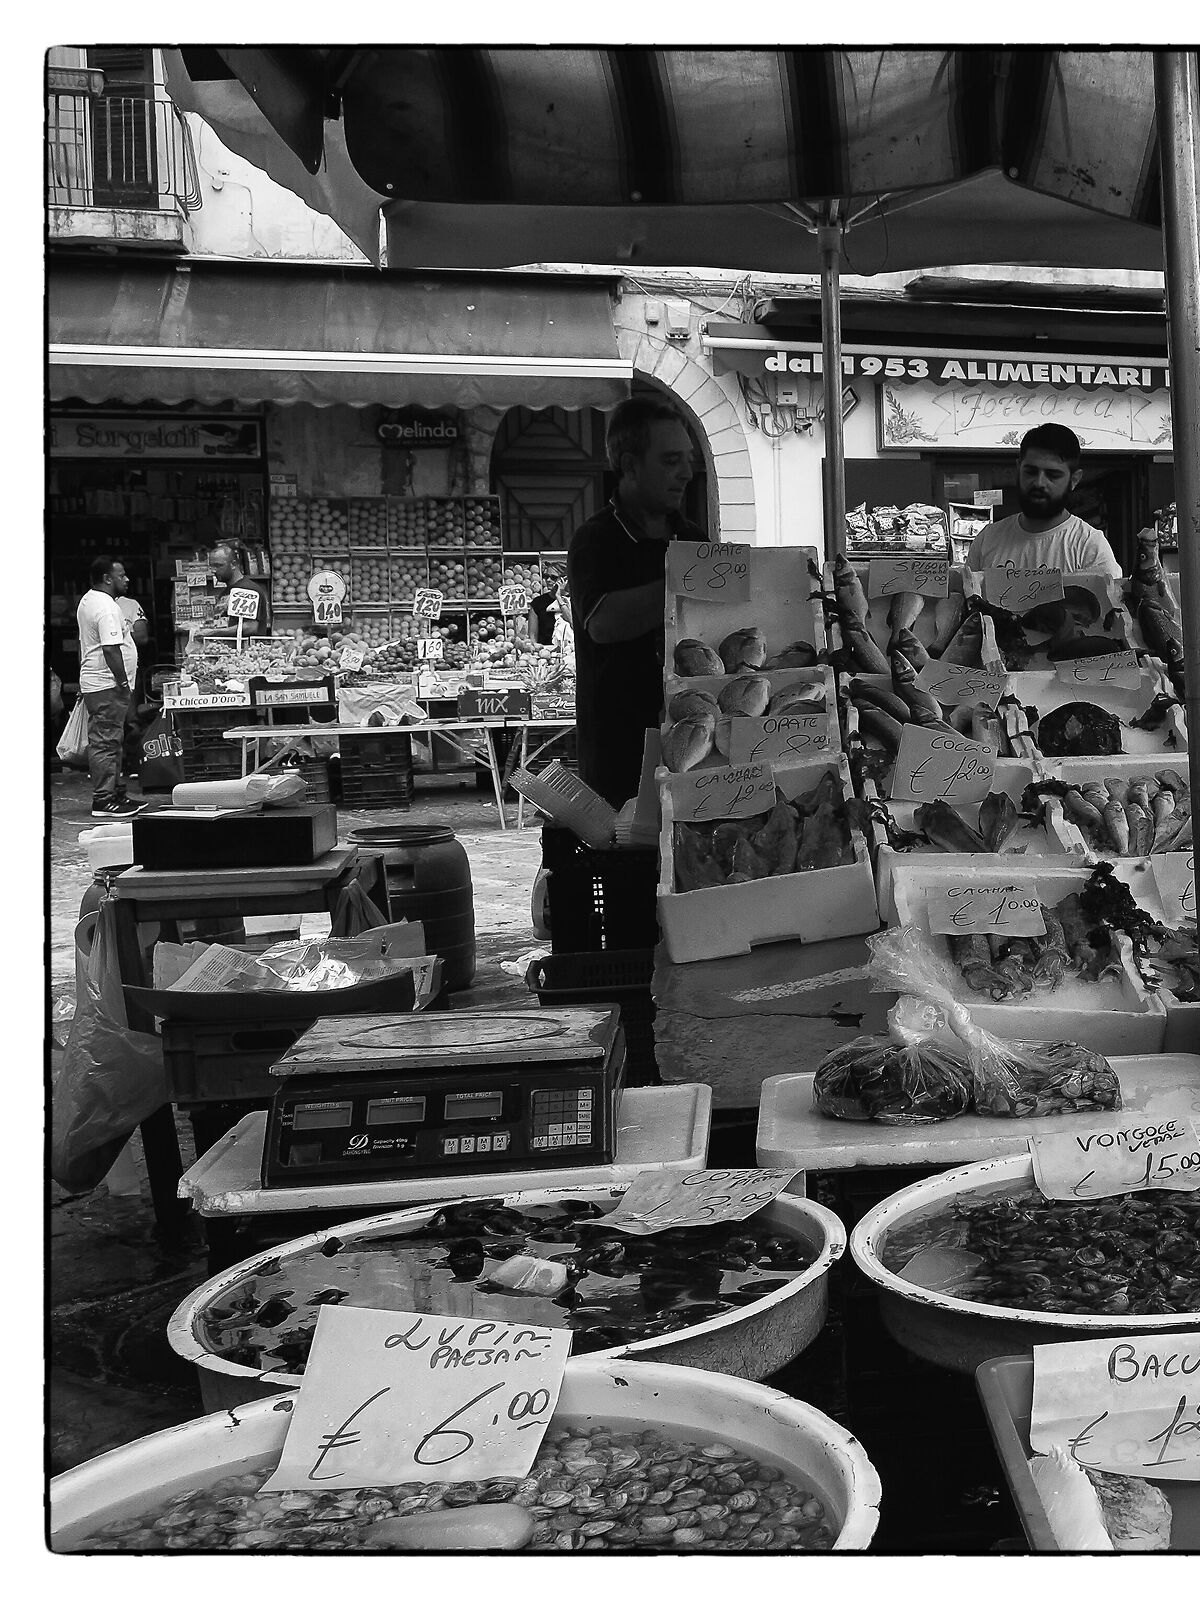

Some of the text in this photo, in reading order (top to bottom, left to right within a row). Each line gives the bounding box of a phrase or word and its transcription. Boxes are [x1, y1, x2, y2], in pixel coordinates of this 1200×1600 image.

[940, 361, 1151, 387] ALIMENTARI
[378, 420, 458, 438] Melinda
[697, 543, 743, 559] ORATE
[707, 563, 747, 588] 8.00
[180, 696, 236, 706] Chicco D'Oro
[763, 718, 813, 734] ORATE
[949, 897, 1040, 928] € 10.00
[308, 1381, 551, 1481] € 6.00
[1067, 1411, 1109, 1466] €
